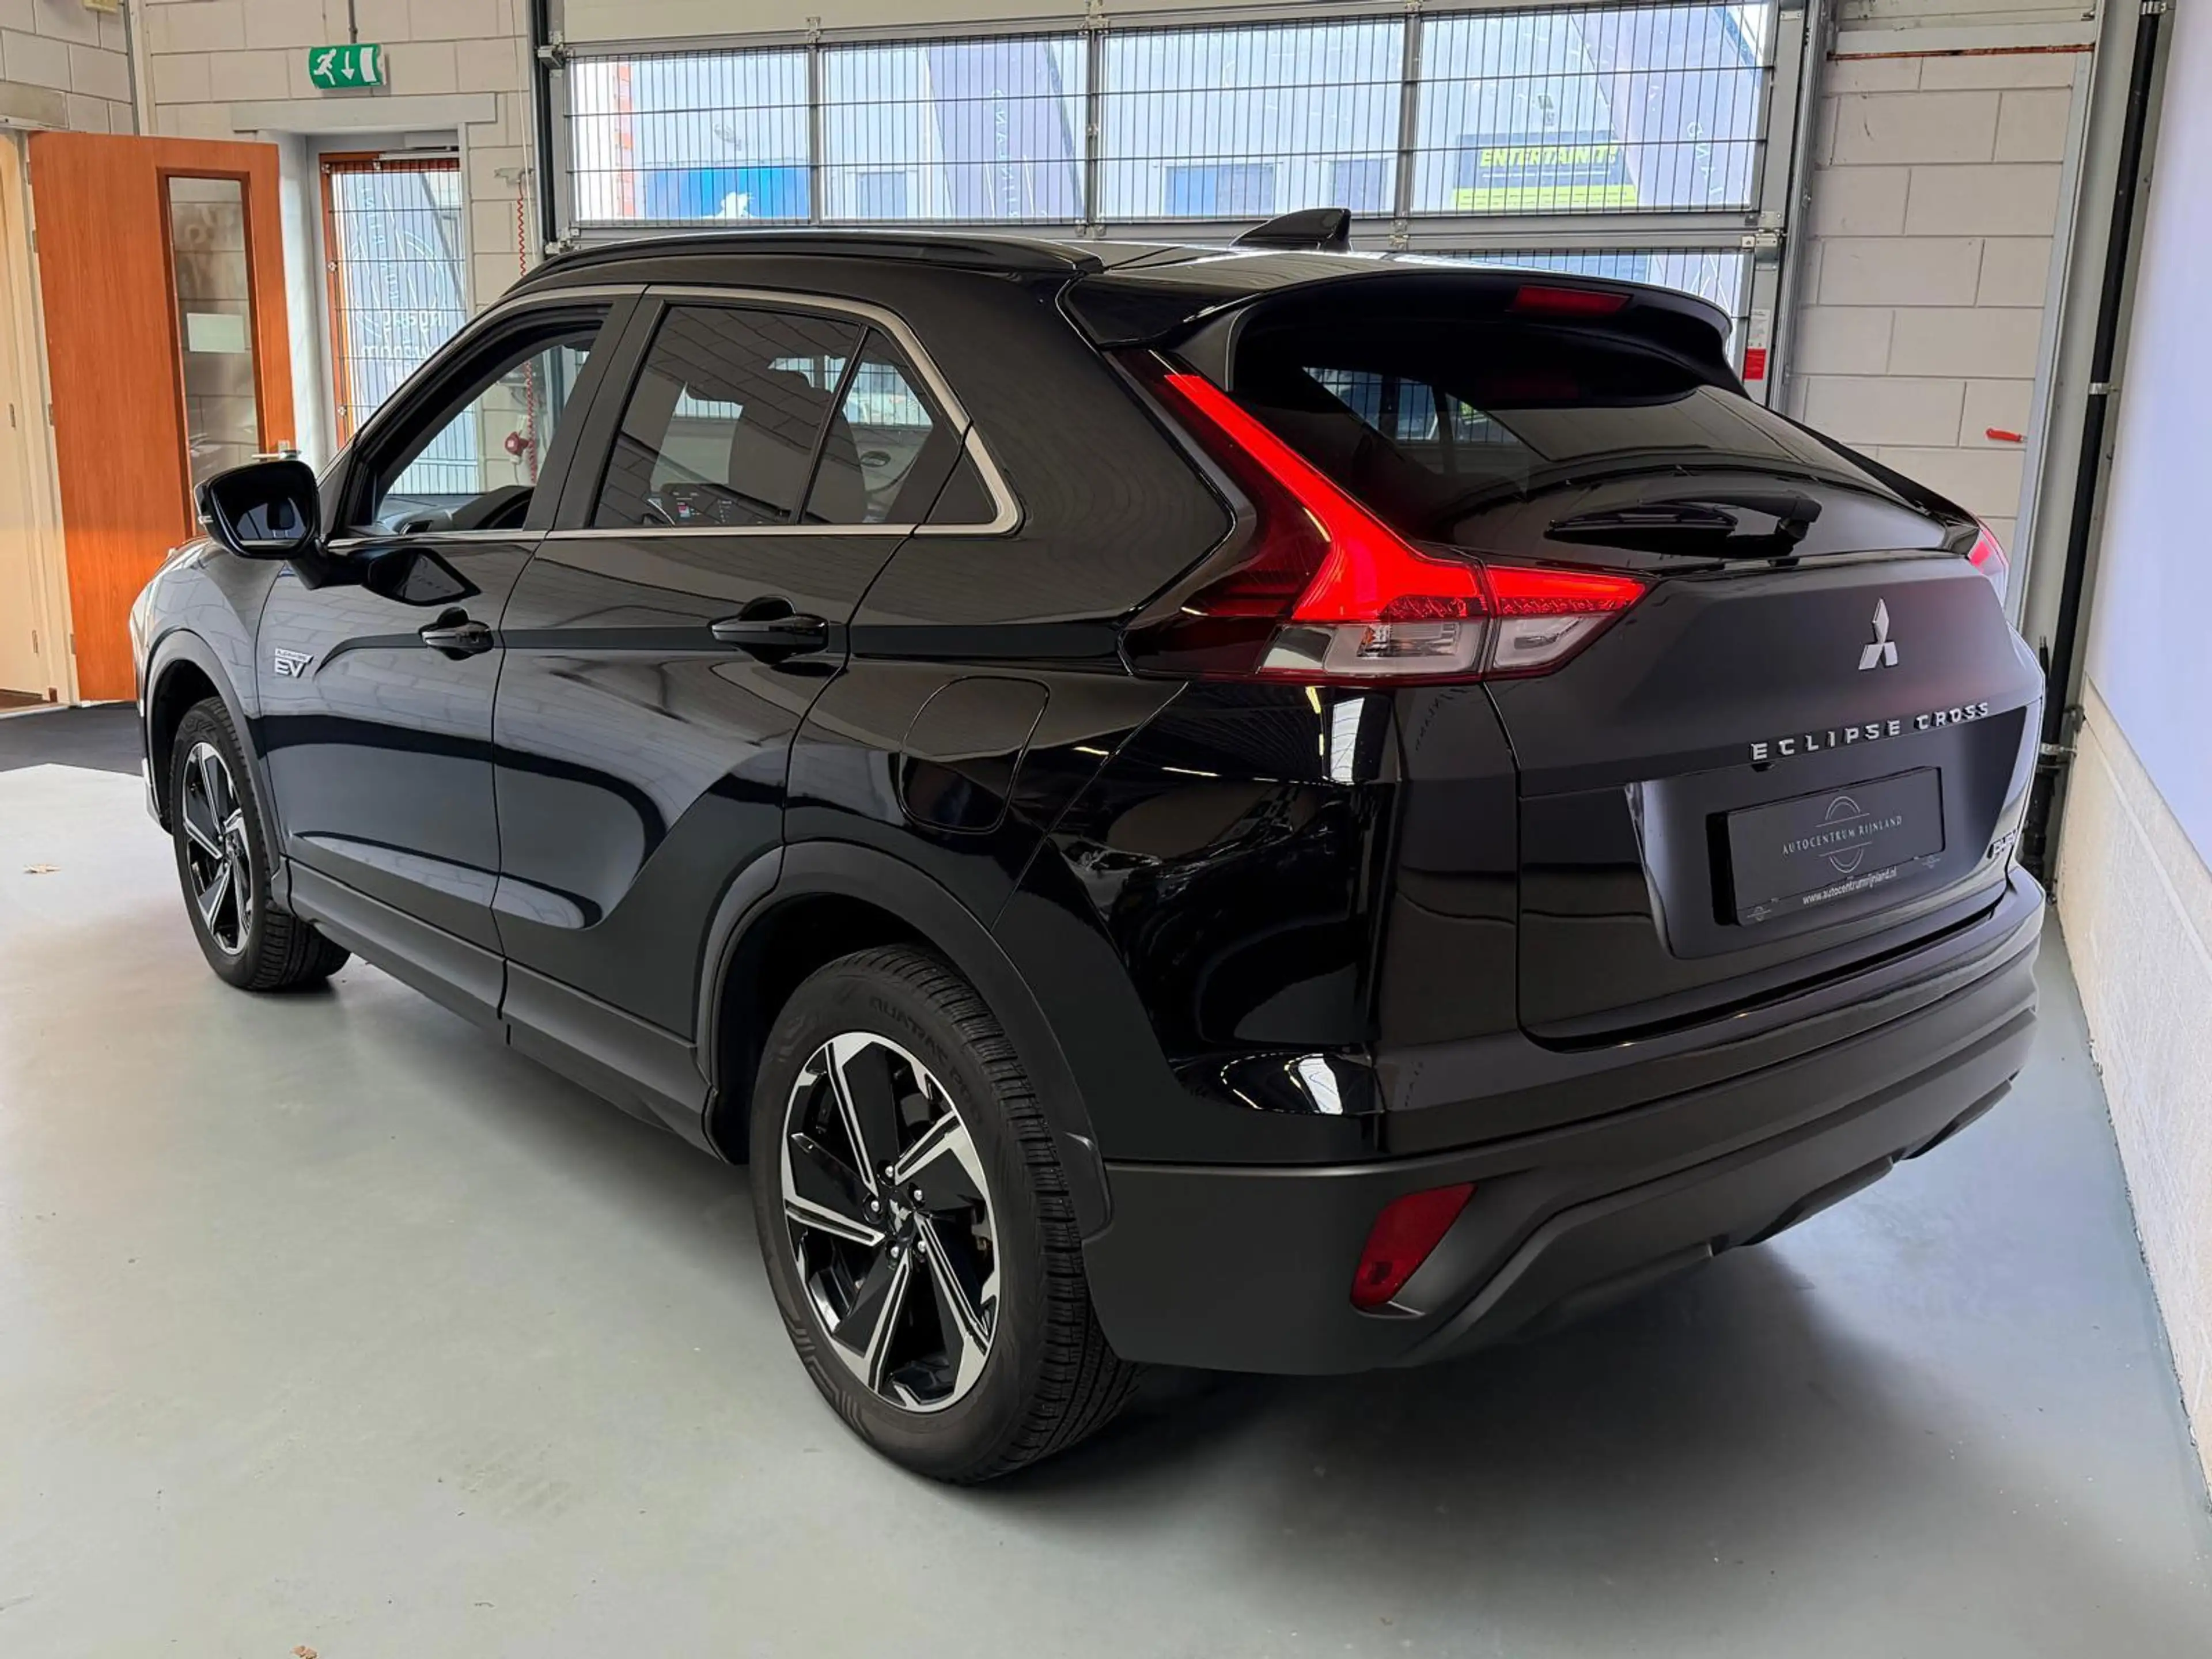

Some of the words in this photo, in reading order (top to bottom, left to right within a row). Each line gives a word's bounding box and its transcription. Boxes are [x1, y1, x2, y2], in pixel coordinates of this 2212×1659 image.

[1751, 719, 1900, 760] ECLIPSE
[1916, 702, 1988, 731] CROSS
[1782, 829, 1855, 855] AUTOCENTRUM
[1858, 815, 1903, 835] RIJNLAND
